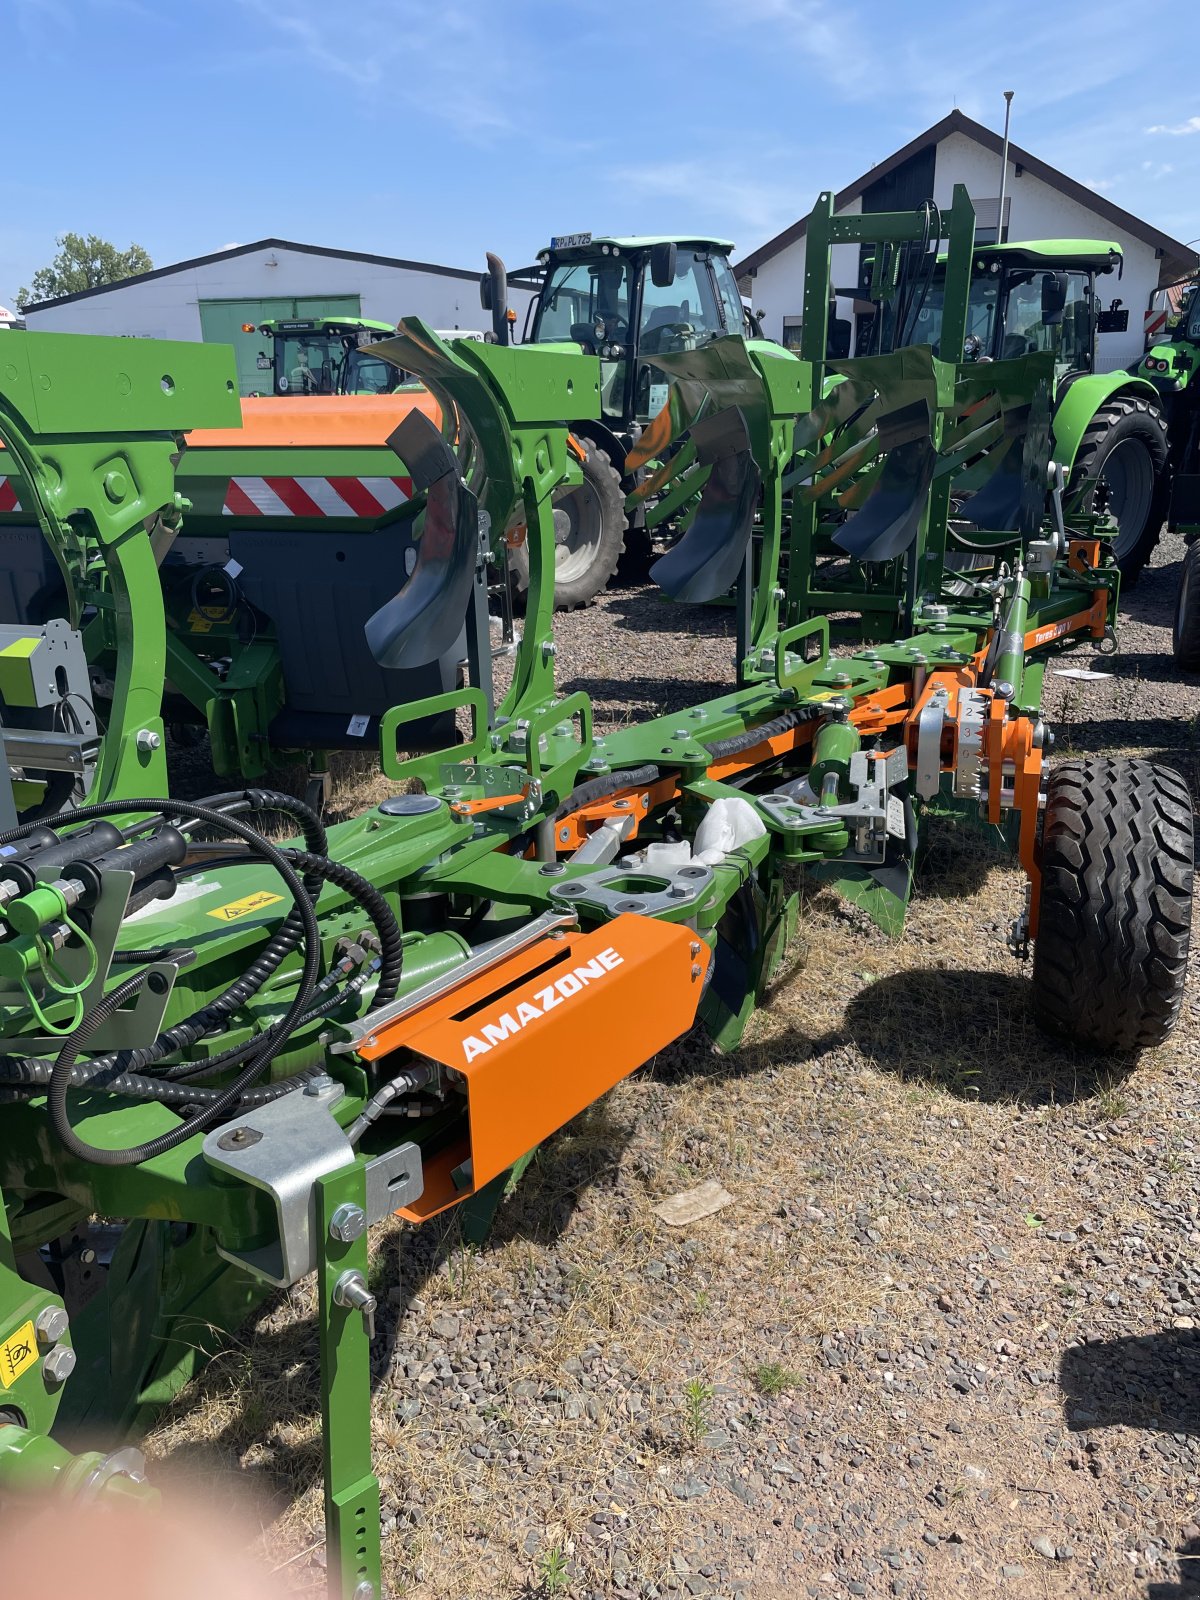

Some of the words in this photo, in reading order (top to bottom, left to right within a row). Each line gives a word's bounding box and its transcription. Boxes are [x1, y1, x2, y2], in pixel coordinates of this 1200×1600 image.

[555, 238, 564, 248] RP
[568, 236, 576, 246] PL
[578, 234, 590, 244] 725
[1035, 629, 1054, 644] Teres
[965, 707, 973, 717] 2
[963, 727, 971, 738] 3
[464, 766, 477, 784] 2
[484, 767, 495, 785] 3
[462, 947, 625, 1064] AMAZONE
